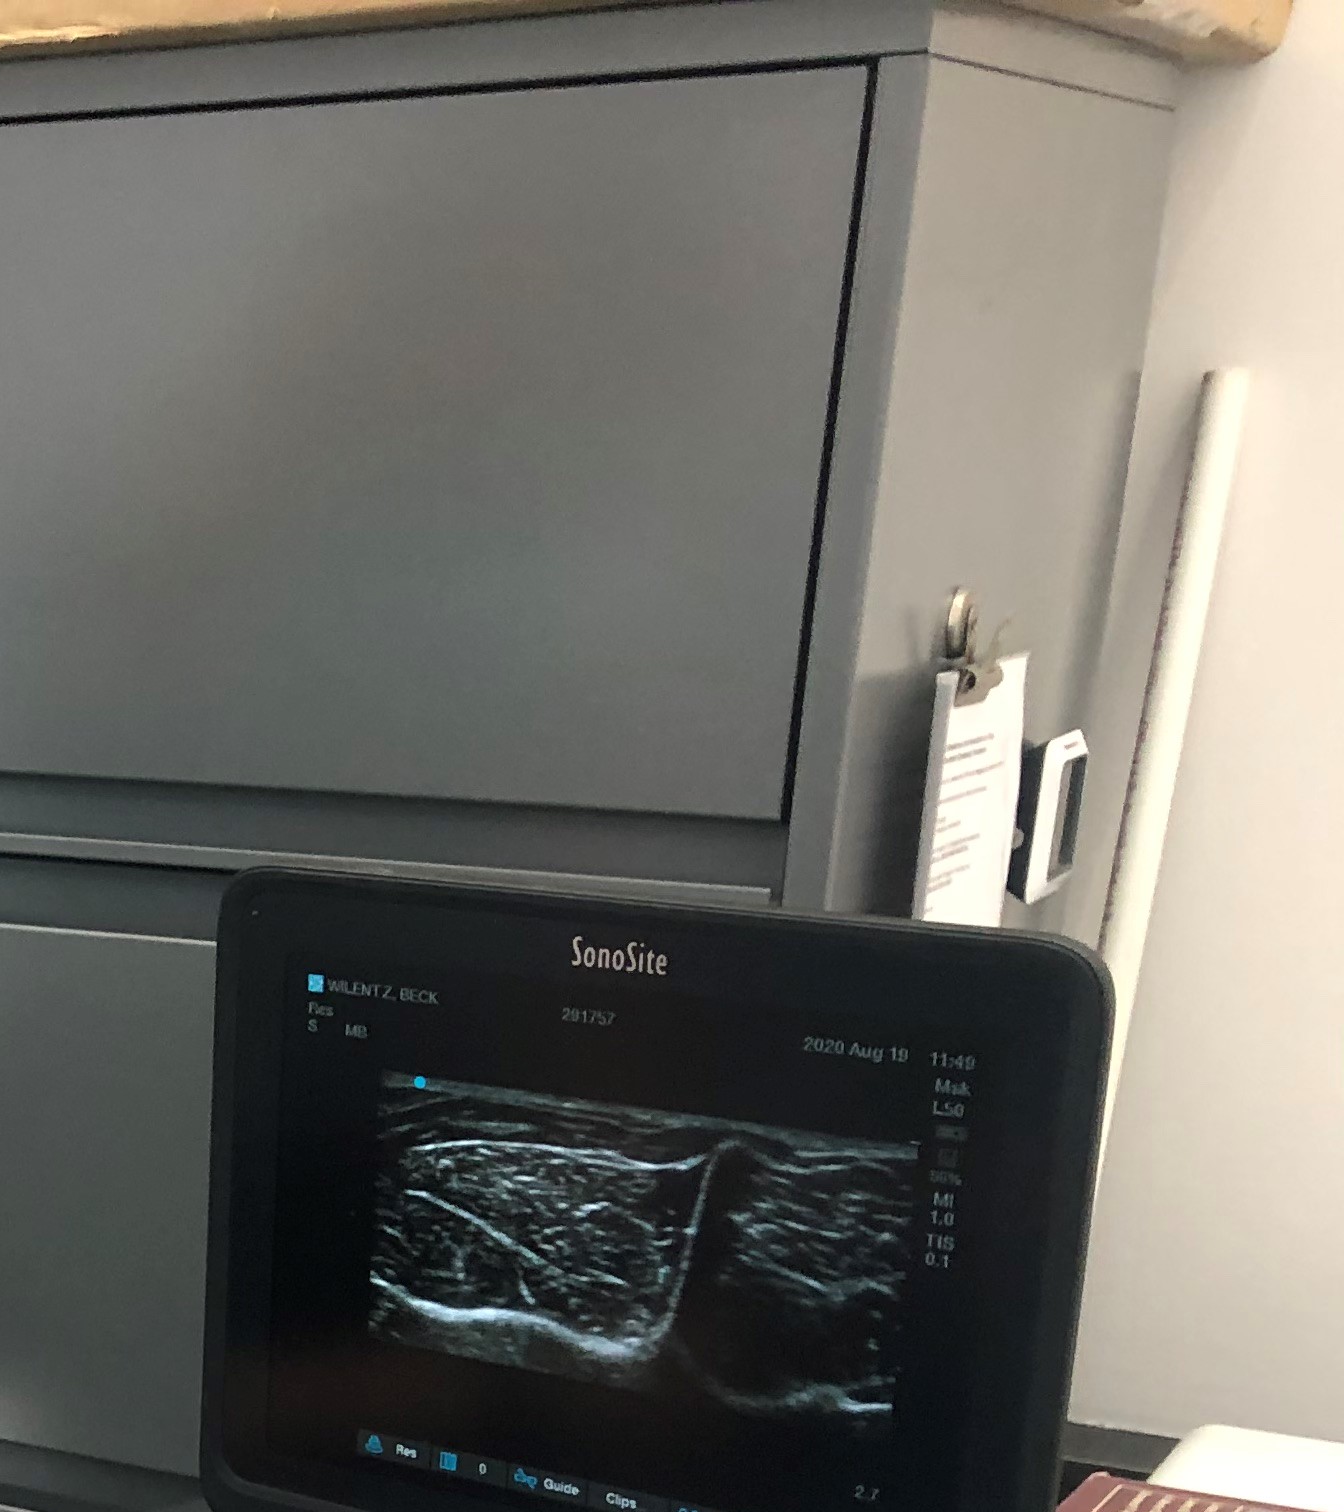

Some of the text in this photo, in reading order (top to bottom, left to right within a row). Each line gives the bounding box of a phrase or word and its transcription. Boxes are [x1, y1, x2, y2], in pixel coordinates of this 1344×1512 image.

[570, 935, 669, 976] SonoSite
[399, 986, 440, 1006] BECK
[803, 1036, 845, 1055] 2020
[849, 1041, 884, 1063] Aug
[930, 1209, 955, 1228] 1.0
[924, 1251, 951, 1269] 0.1
[543, 1477, 580, 1496] Guide
